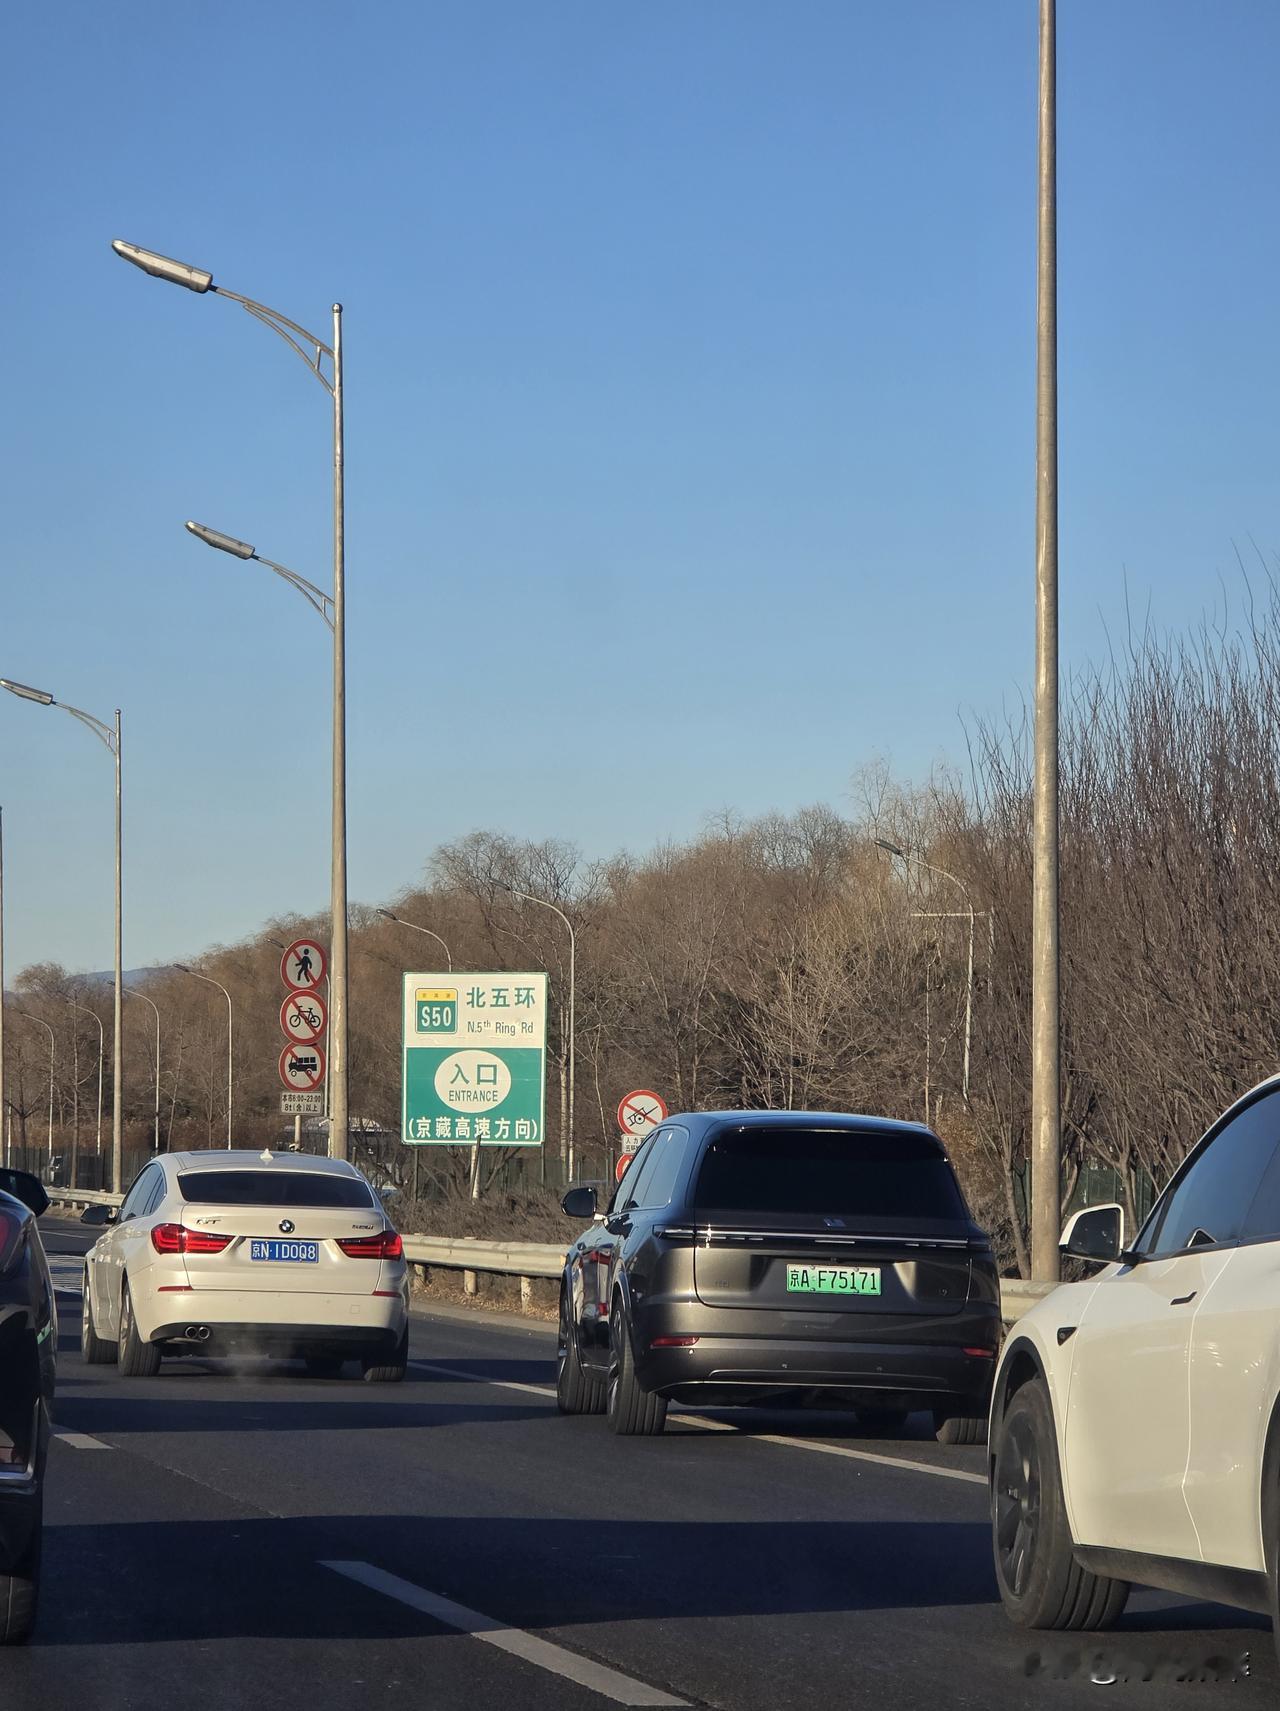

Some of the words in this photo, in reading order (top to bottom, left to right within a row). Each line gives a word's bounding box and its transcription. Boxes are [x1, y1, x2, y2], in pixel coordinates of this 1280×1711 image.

[466, 987, 536, 1009] 北五环
[421, 1006, 452, 1027] S50
[495, 1021, 516, 1036] Ring
[521, 1021, 534, 1033] Rd
[450, 1063, 498, 1085] 入口
[448, 1090, 498, 1102] ENTRANCE
[408, 1116, 538, 1140] (京藏高速方向)
